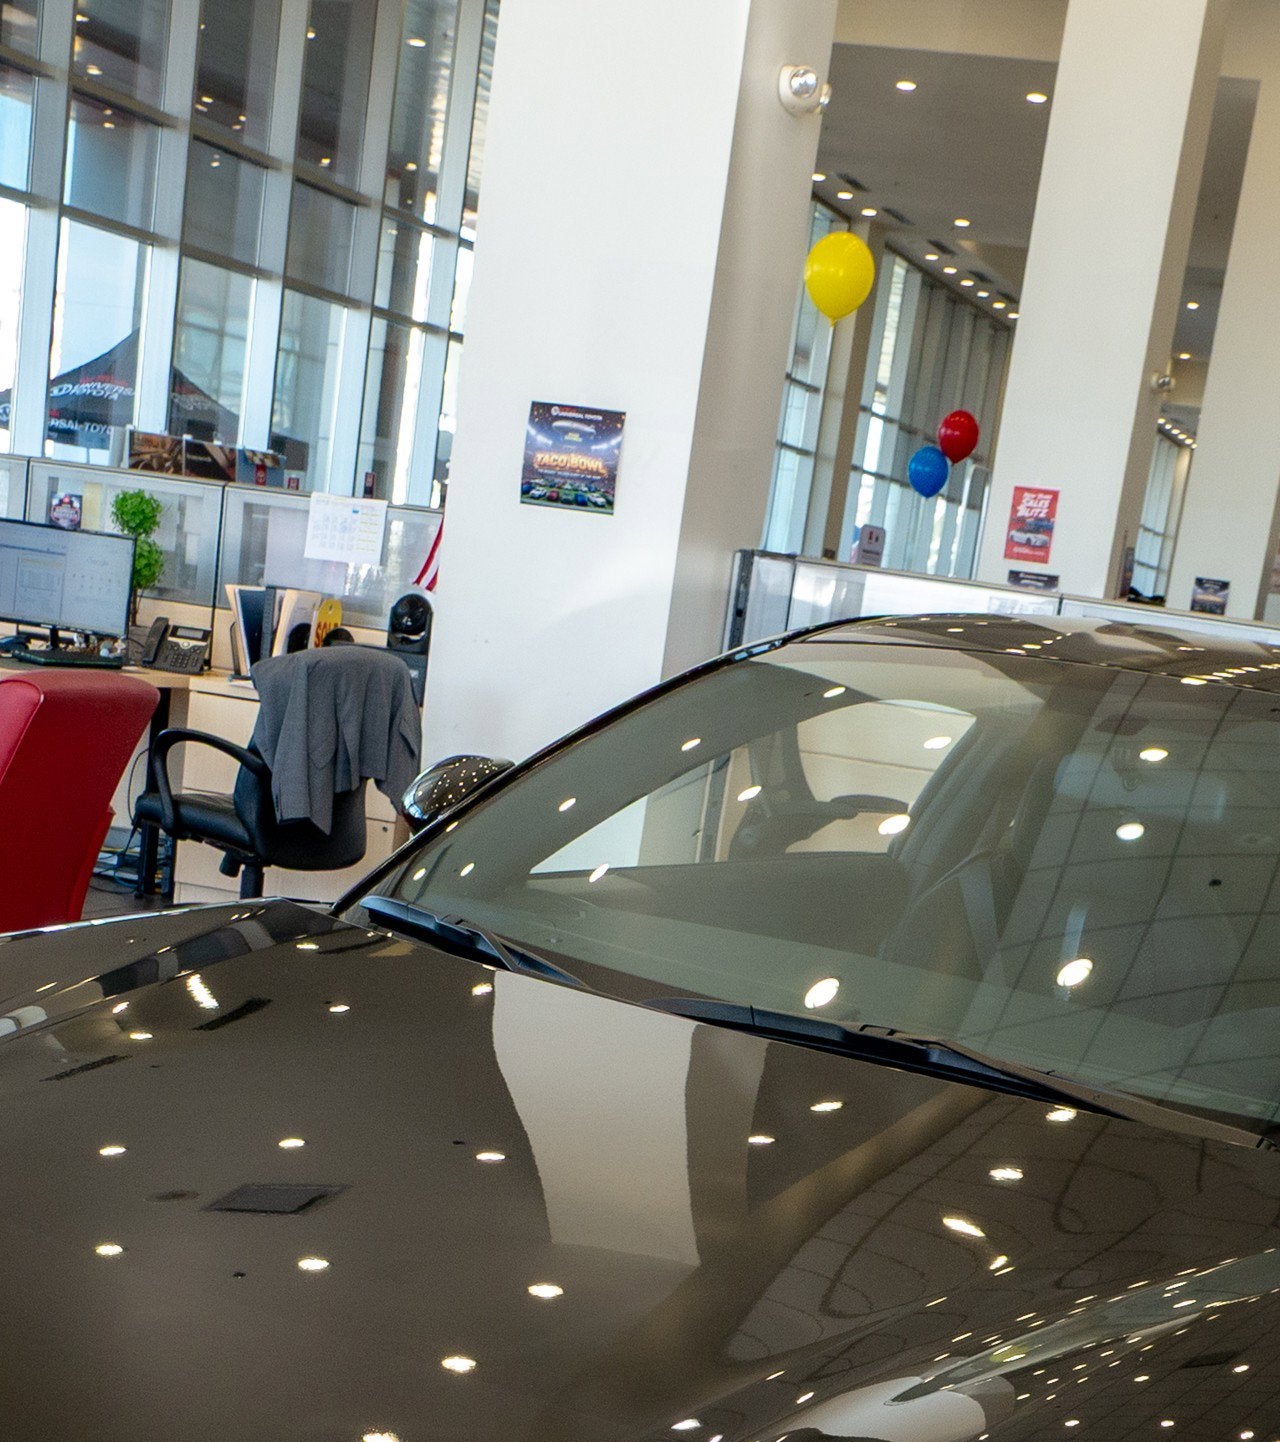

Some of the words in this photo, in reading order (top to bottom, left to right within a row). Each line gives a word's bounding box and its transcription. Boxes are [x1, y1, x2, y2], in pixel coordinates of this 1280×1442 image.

[536, 453, 567, 468] TACO
[569, 454, 607, 474] BOWL
[1022, 498, 1051, 509] SALES
[1017, 505, 1049, 518] BLITZ
